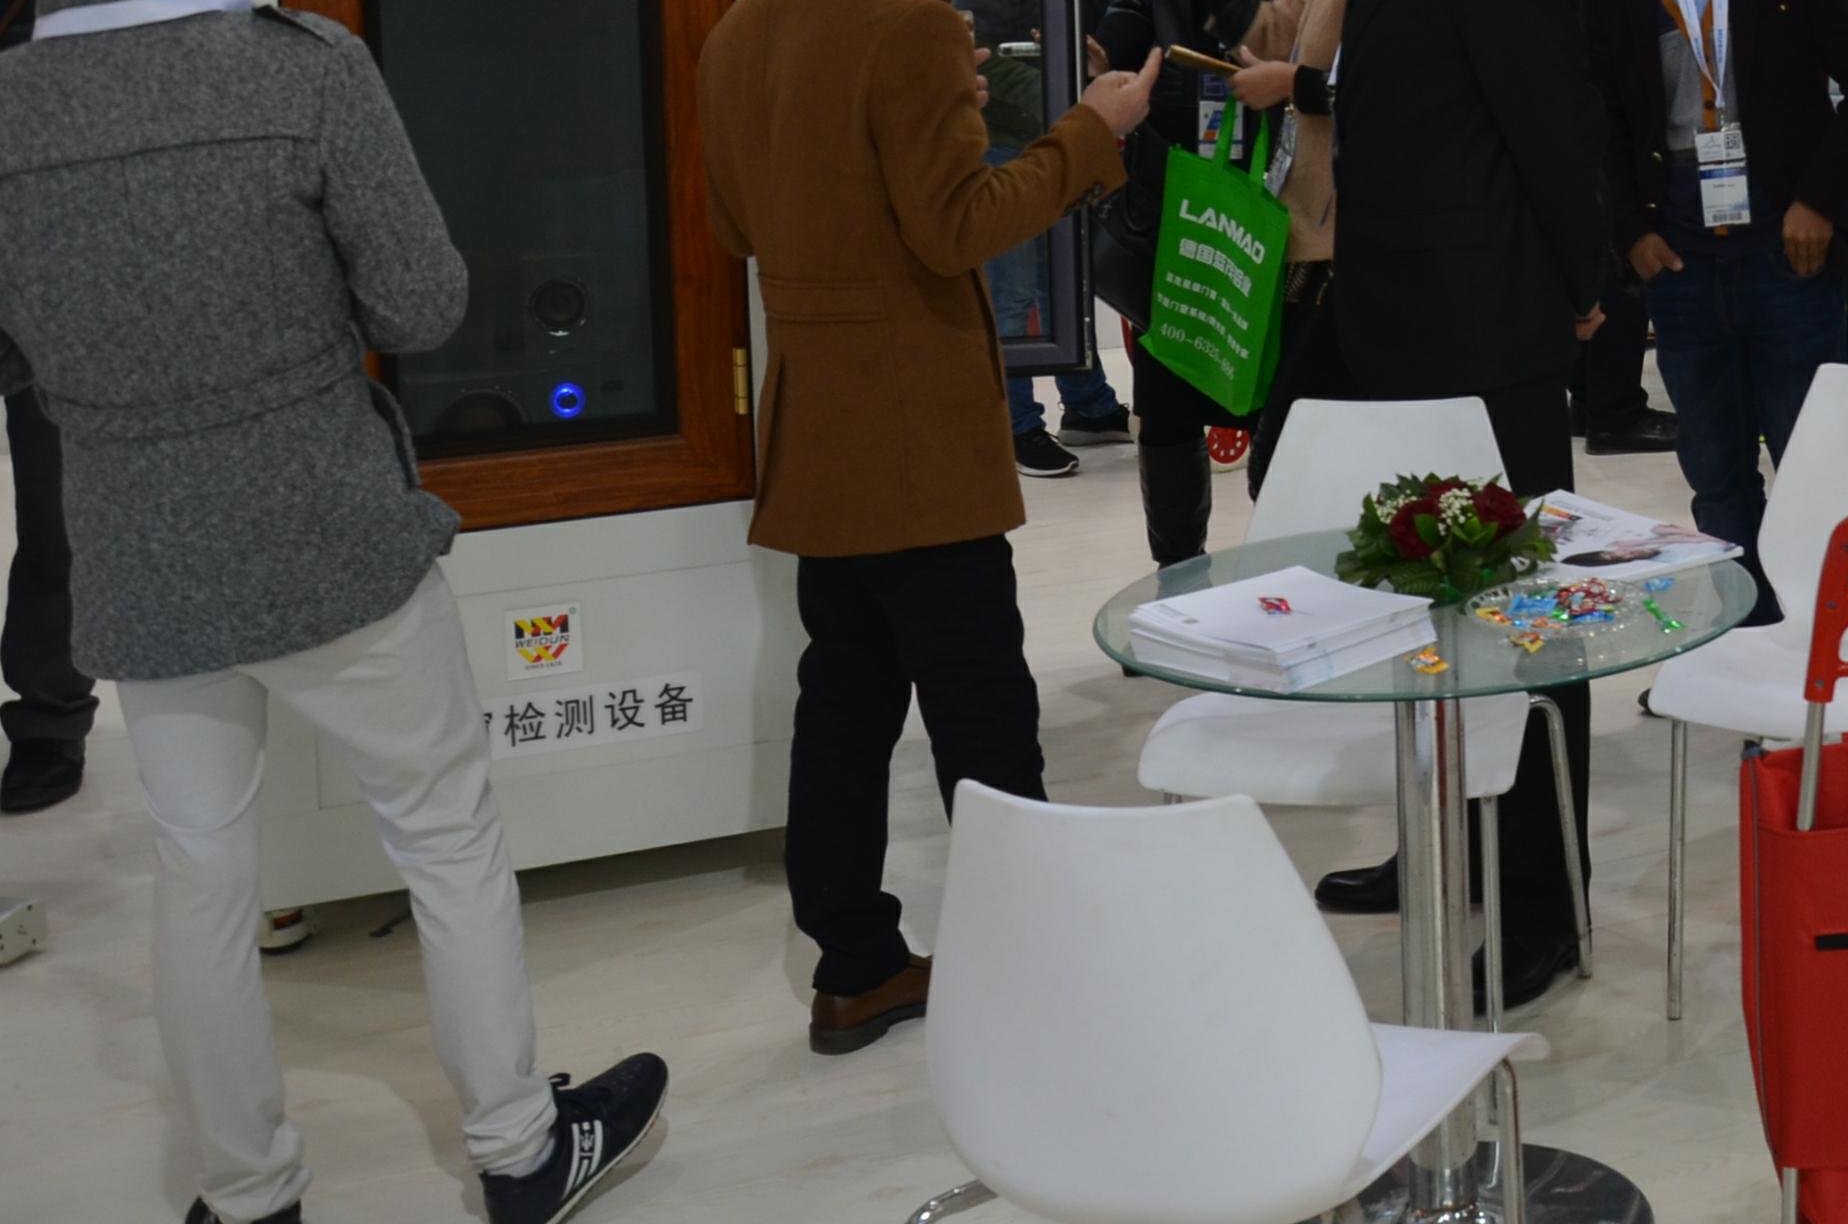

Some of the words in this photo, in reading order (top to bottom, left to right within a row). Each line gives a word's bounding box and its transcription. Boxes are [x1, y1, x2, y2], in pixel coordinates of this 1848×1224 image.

[1179, 198, 1266, 265] LANMAO
[514, 634, 570, 649] WEIDUN
[484, 682, 694, 748] 检测设备
